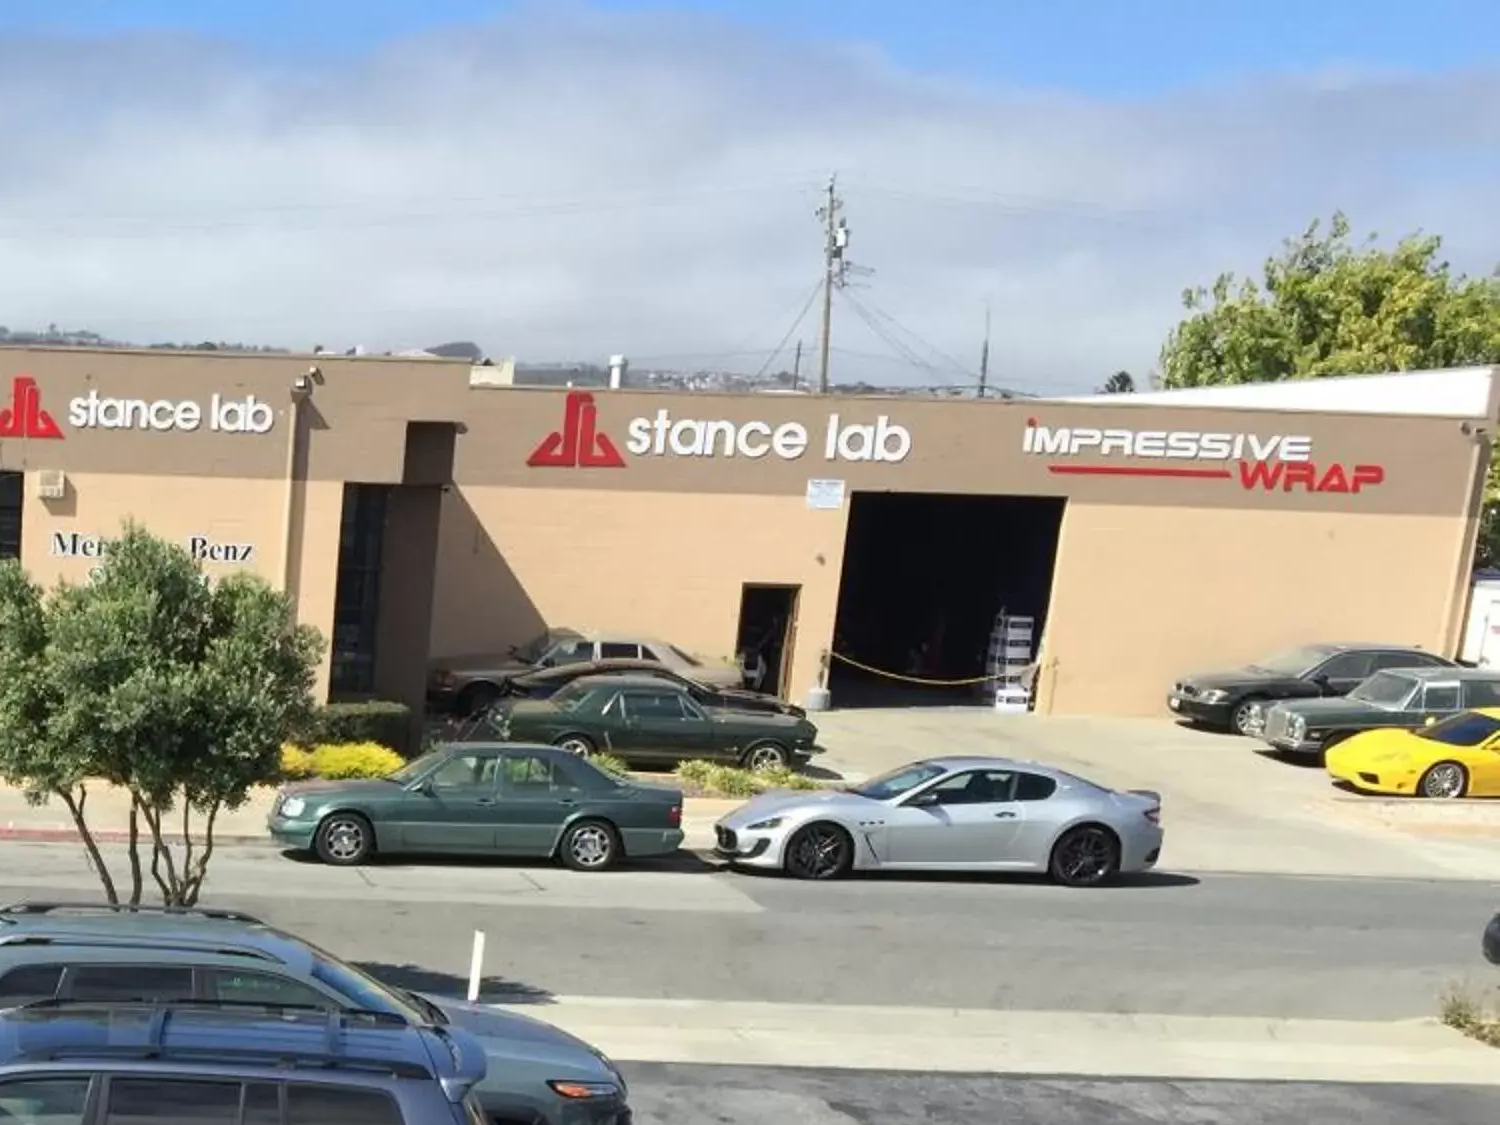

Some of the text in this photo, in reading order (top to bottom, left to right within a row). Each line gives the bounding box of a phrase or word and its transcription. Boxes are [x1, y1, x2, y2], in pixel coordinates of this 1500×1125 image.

[68, 390, 274, 434] stance lab
[627, 409, 911, 462] stance lab
[1238, 460, 1384, 494] WRAP
